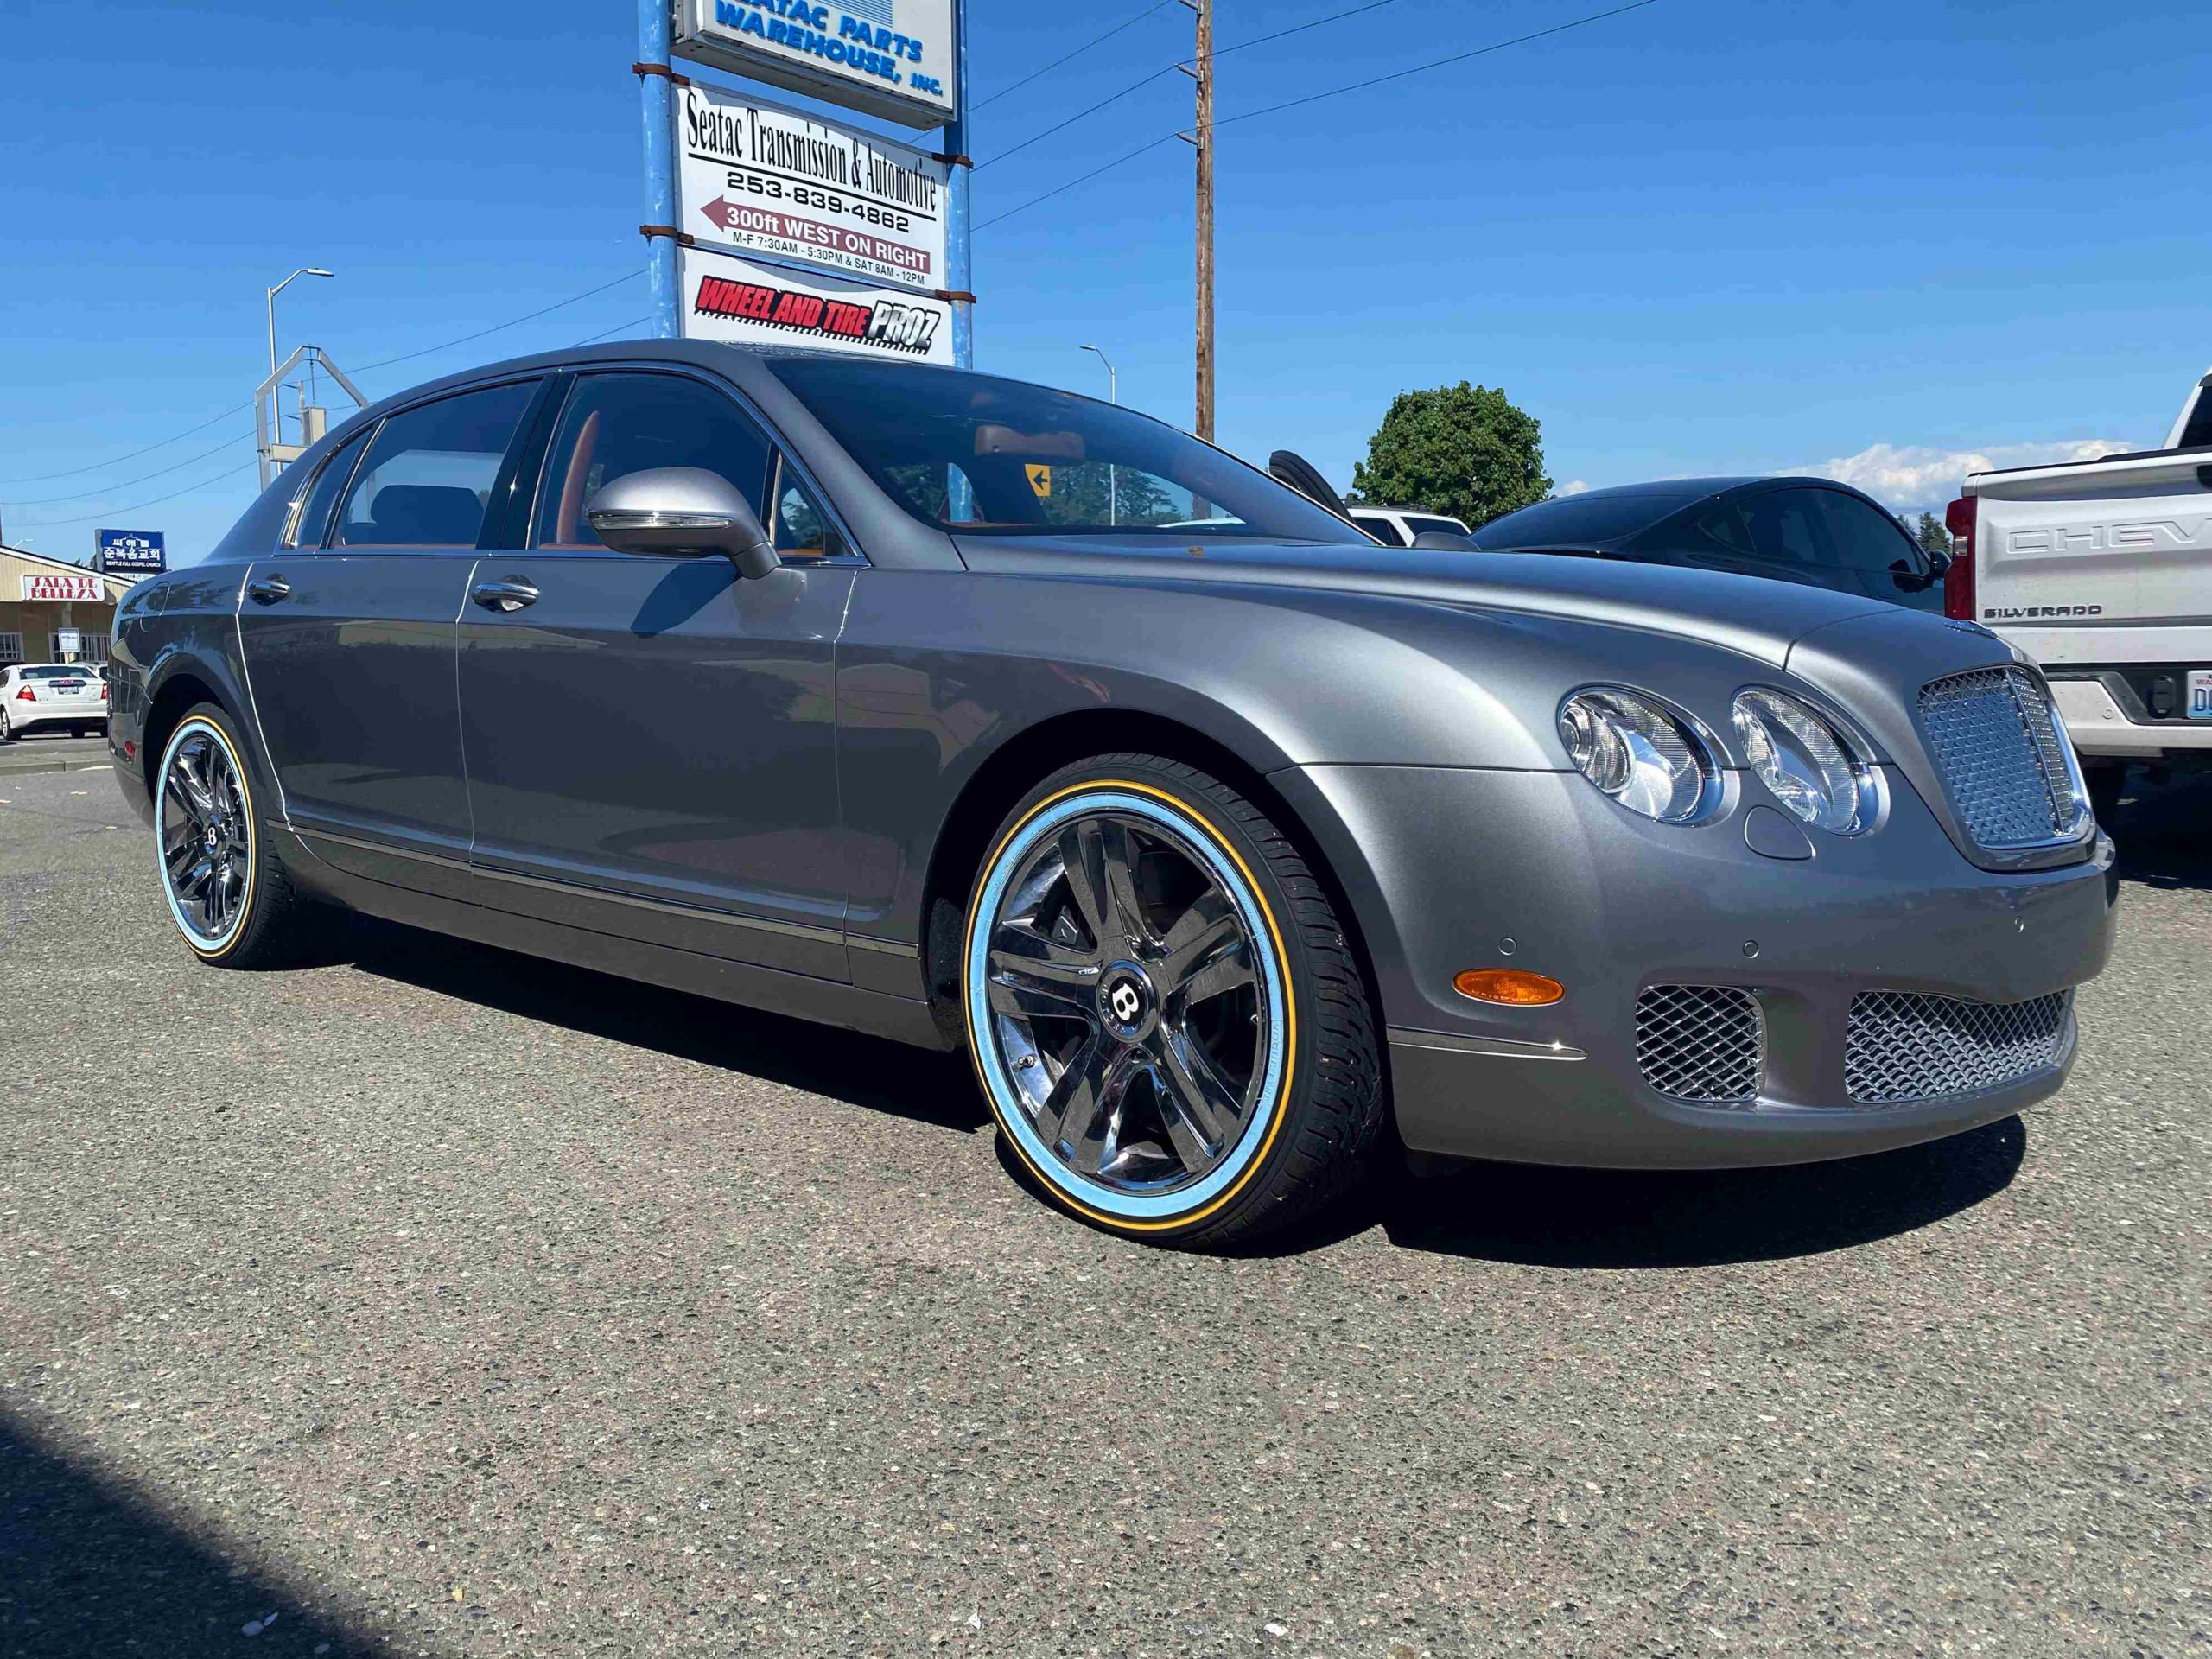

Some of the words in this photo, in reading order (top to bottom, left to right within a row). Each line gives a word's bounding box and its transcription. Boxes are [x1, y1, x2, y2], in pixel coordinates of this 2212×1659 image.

[715, 0, 902, 85] WAREHOUSE,
[910, 73, 944, 97] INC.
[732, 0, 830, 31] TAC
[837, 14, 923, 62] PARTS
[687, 91, 743, 158] Seatac
[747, 107, 847, 185] Transmission
[851, 137, 862, 190] &
[866, 142, 937, 212] Automotive
[727, 171, 910, 233] 253-839-4862
[727, 207, 779, 234] 300ft
[784, 218, 841, 246] WEST
[845, 233, 871, 256] ON
[875, 241, 927, 270] RIGHT
[733, 232, 754, 245] M-F
[757, 236, 798, 254] 7:30AM
[807, 246, 842, 264] 5:30PM
[845, 256, 852, 266] &
[855, 257, 874, 272] SAT
[875, 264, 894, 277] 8AM
[902, 270, 925, 285] 12PM
[696, 276, 776, 320] WHEEL
[772, 292, 823, 327] AND
[823, 300, 871, 337] TIRE
[867, 299, 941, 349] PROZ
[33, 577, 73, 588] SALA
[79, 578, 97, 588] DE
[104, 547, 161, 561] 순복음교회
[30, 588, 97, 600] BELLEZA
[1984, 605, 2102, 619] SILVERADO
[1112, 983, 1139, 1021] B
